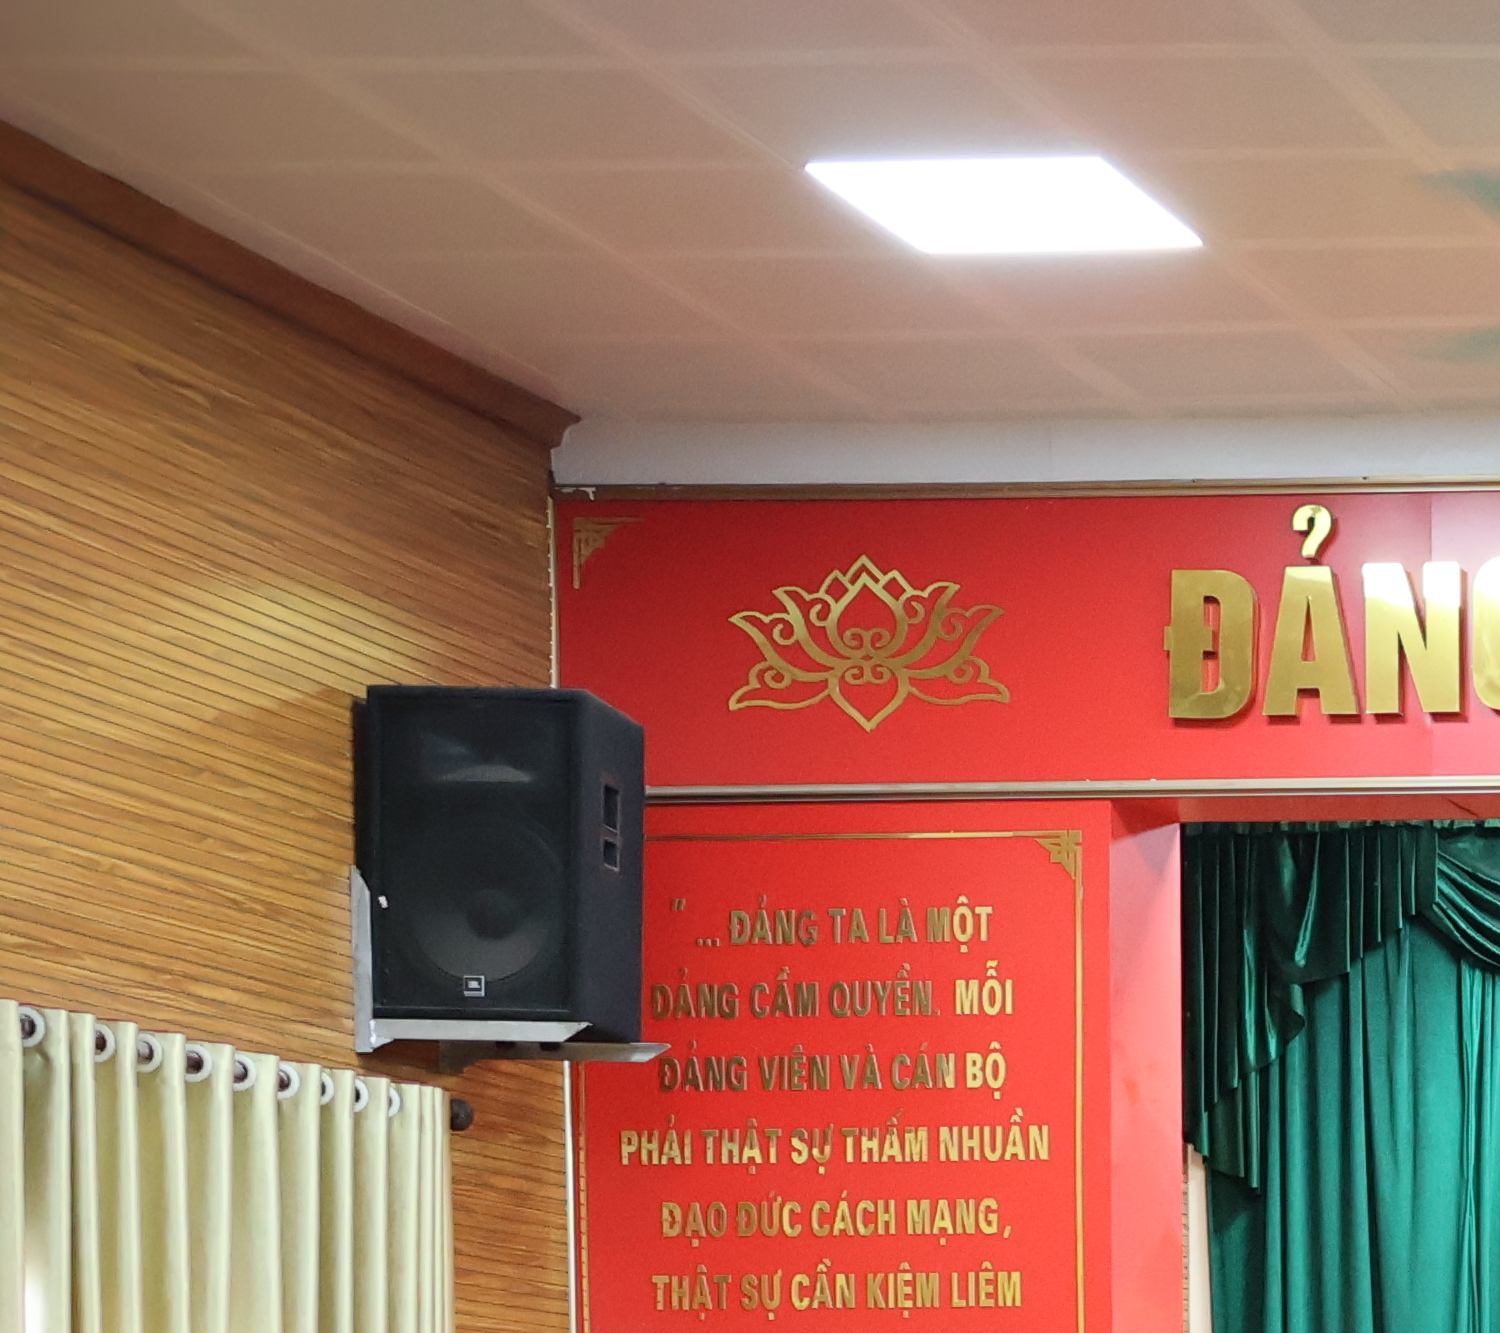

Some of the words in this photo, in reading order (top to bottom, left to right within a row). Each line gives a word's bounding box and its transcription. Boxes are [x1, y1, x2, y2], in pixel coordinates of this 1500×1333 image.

[730, 895, 817, 946] ĐẢNG
[829, 909, 869, 943] TA
[880, 896, 917, 943] LÀ
[928, 896, 993, 953] MỘT
[652, 967, 740, 1019] ĐẢNG
[753, 967, 818, 1017] CẦM
[832, 963, 941, 1017] QUYỀN.
[956, 960, 1013, 1015] MỖI
[659, 1040, 747, 1091] ĐẢNG
[761, 1045, 829, 1090] VIÊN
[841, 1044, 882, 1089] VÀ
[892, 1042, 956, 1089] CÁN
[966, 1041, 1006, 1099] BỘ
[622, 1114, 691, 1164] PHẢI
[703, 1119, 781, 1173] THẬT
[791, 1124, 833, 1174] SỰ
[842, 1108, 928, 1162] THẤM
[939, 1108, 1049, 1161] NHUẦN
[662, 1202, 726, 1246] ĐẠO
[737, 1190, 802, 1237] ĐỨC
[812, 1190, 896, 1236] CÁCH
[652, 1265, 731, 1319] THẬT
[742, 1270, 782, 1320] SỰ
[791, 1259, 855, 1310] CẦN
[867, 1262, 940, 1318] KIỆM
[952, 1261, 1022, 1307] LIÊM
